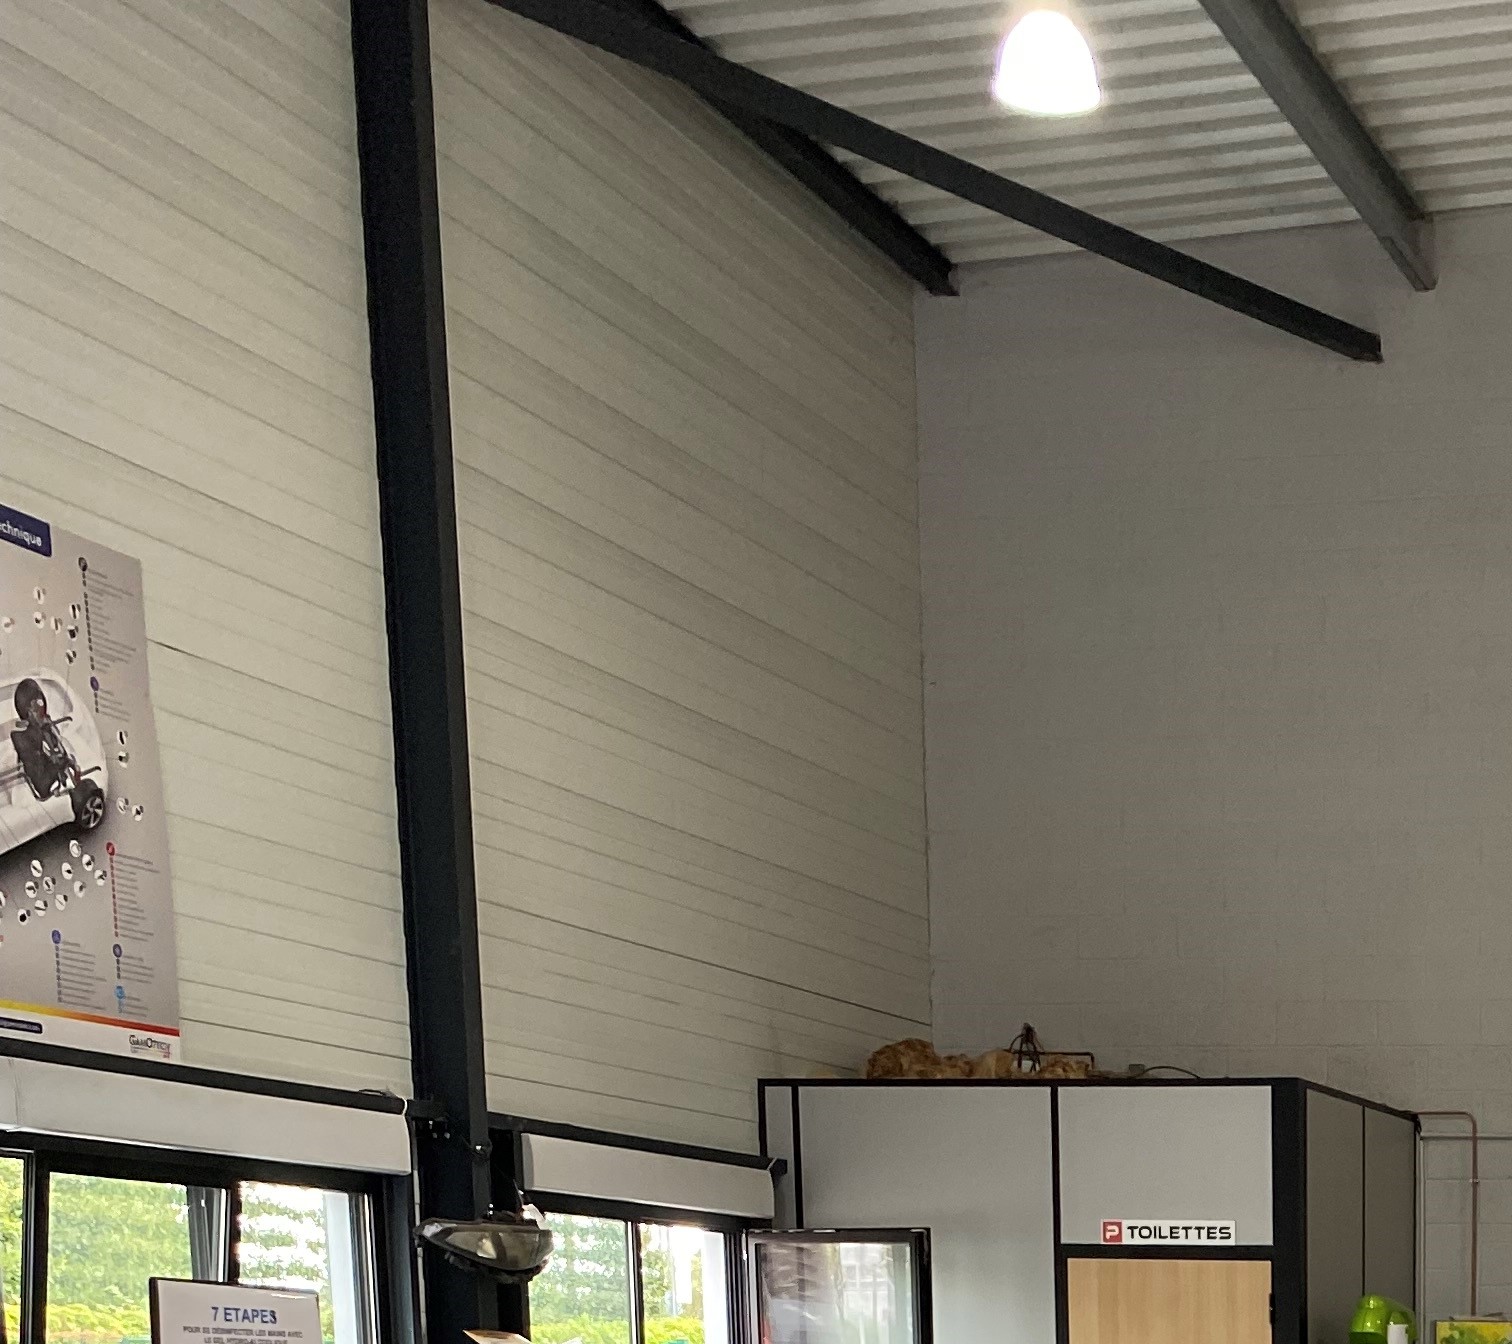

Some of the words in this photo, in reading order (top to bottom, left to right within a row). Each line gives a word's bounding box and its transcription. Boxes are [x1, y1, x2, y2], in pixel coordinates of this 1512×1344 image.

[1127, 1225, 1232, 1240] TOILETTES
[211, 1306, 219, 1322] 7
[223, 1307, 278, 1325] ETAPES
